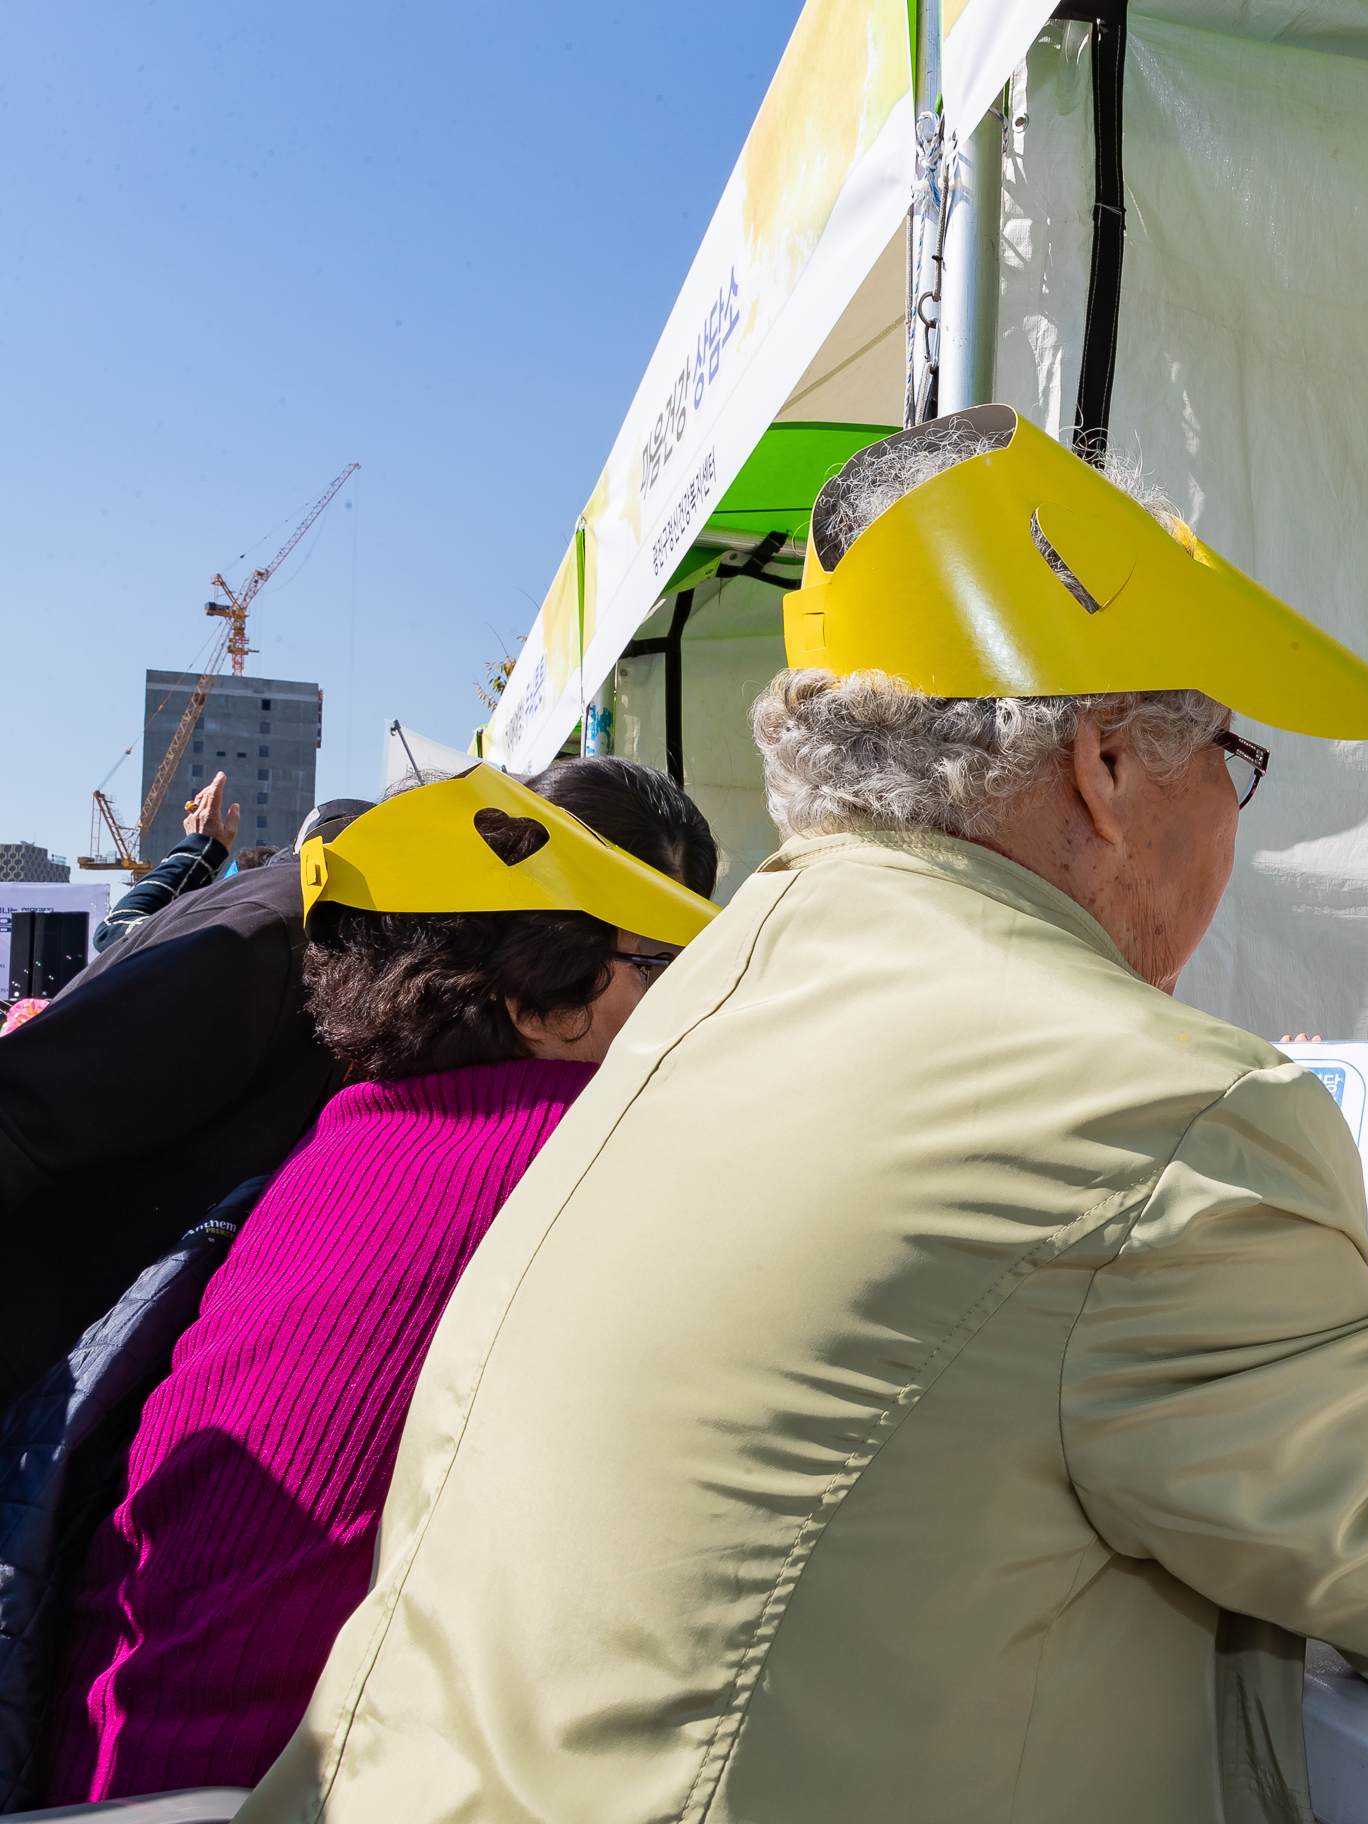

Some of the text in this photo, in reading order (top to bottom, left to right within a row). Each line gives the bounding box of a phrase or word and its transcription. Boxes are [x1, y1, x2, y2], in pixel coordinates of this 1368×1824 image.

[640, 264, 740, 501] 마음건강 상담소
[652, 445, 717, 576] 광진구정신건강복지센터
[181, 1219, 237, 1241] Anthem
